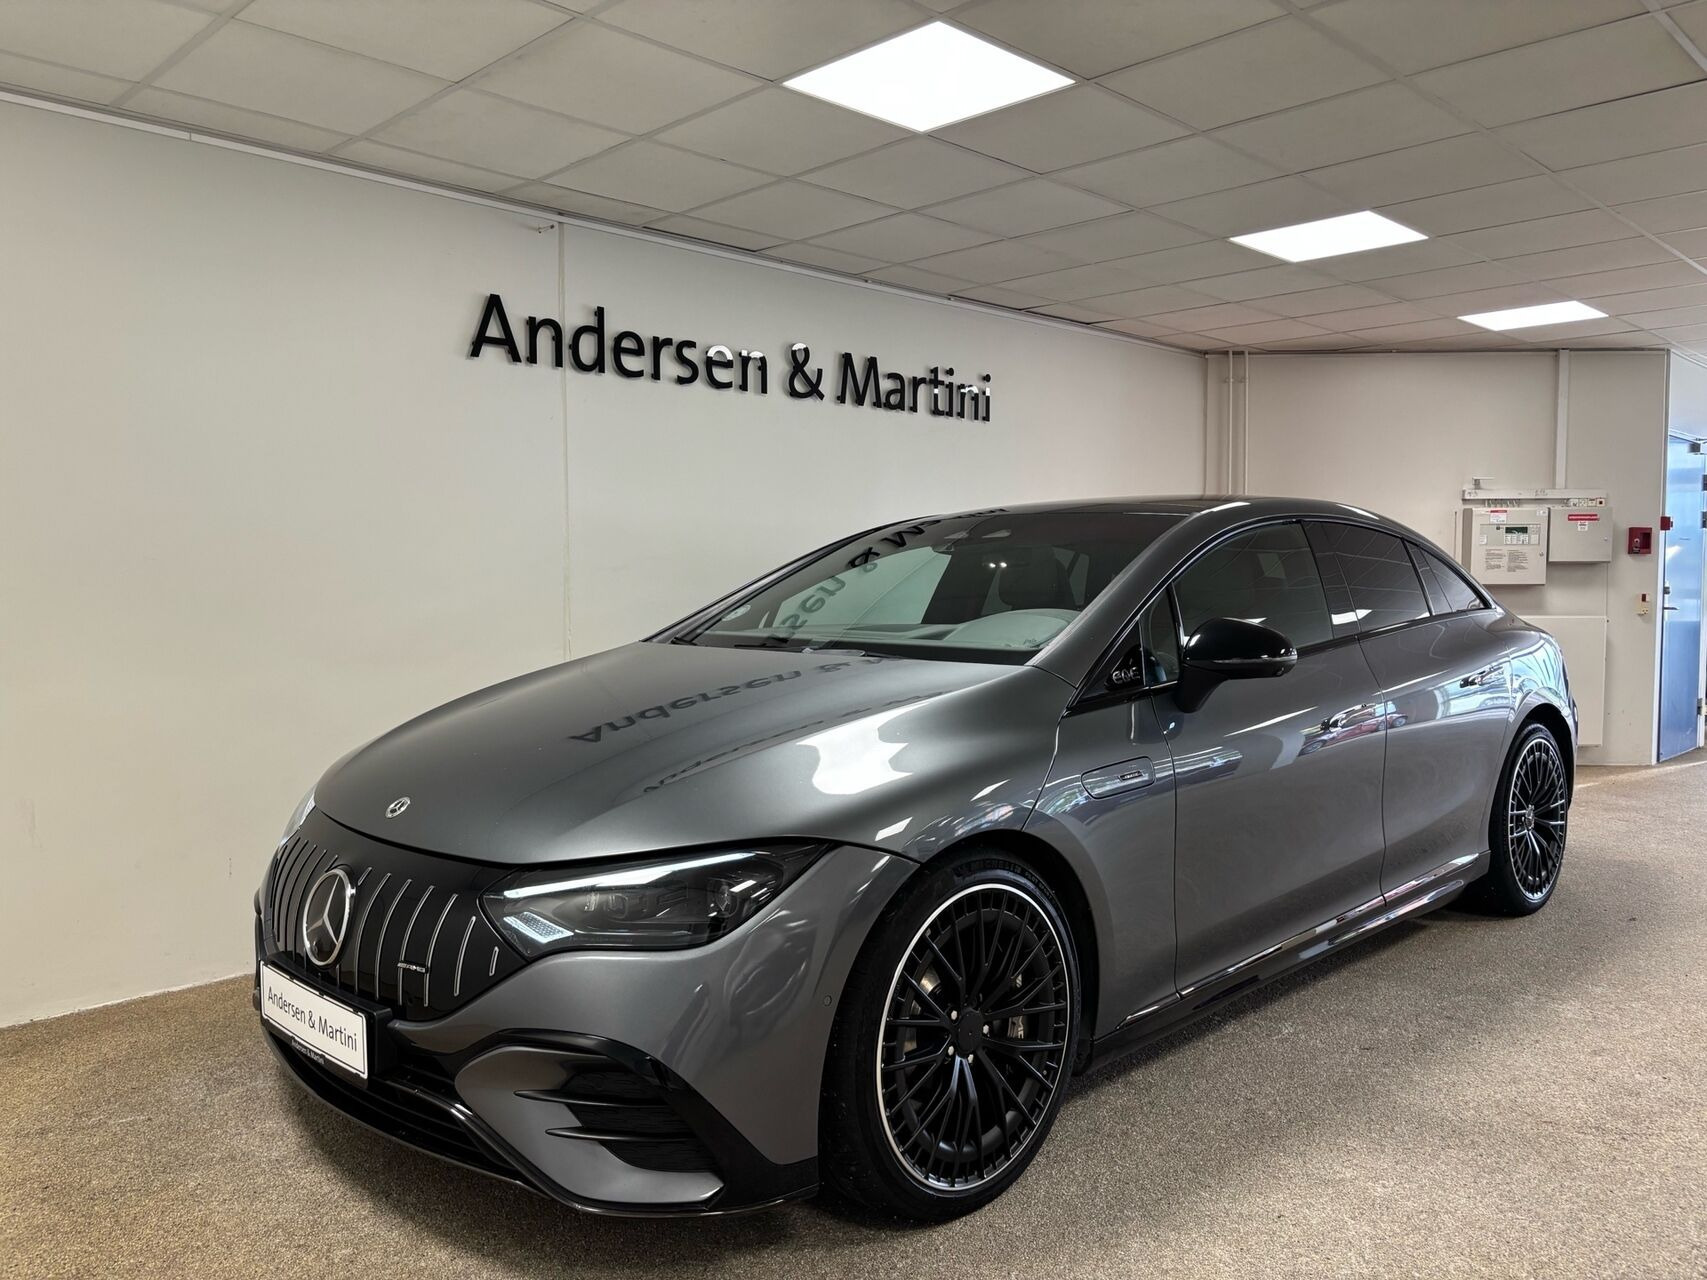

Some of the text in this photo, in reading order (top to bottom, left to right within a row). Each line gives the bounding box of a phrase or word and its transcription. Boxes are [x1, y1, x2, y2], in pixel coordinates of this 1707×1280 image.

[470, 293, 992, 422] Andersen & Martini
[1112, 667, 1141, 685] EQE
[267, 986, 357, 1052] Andersen & Martini
